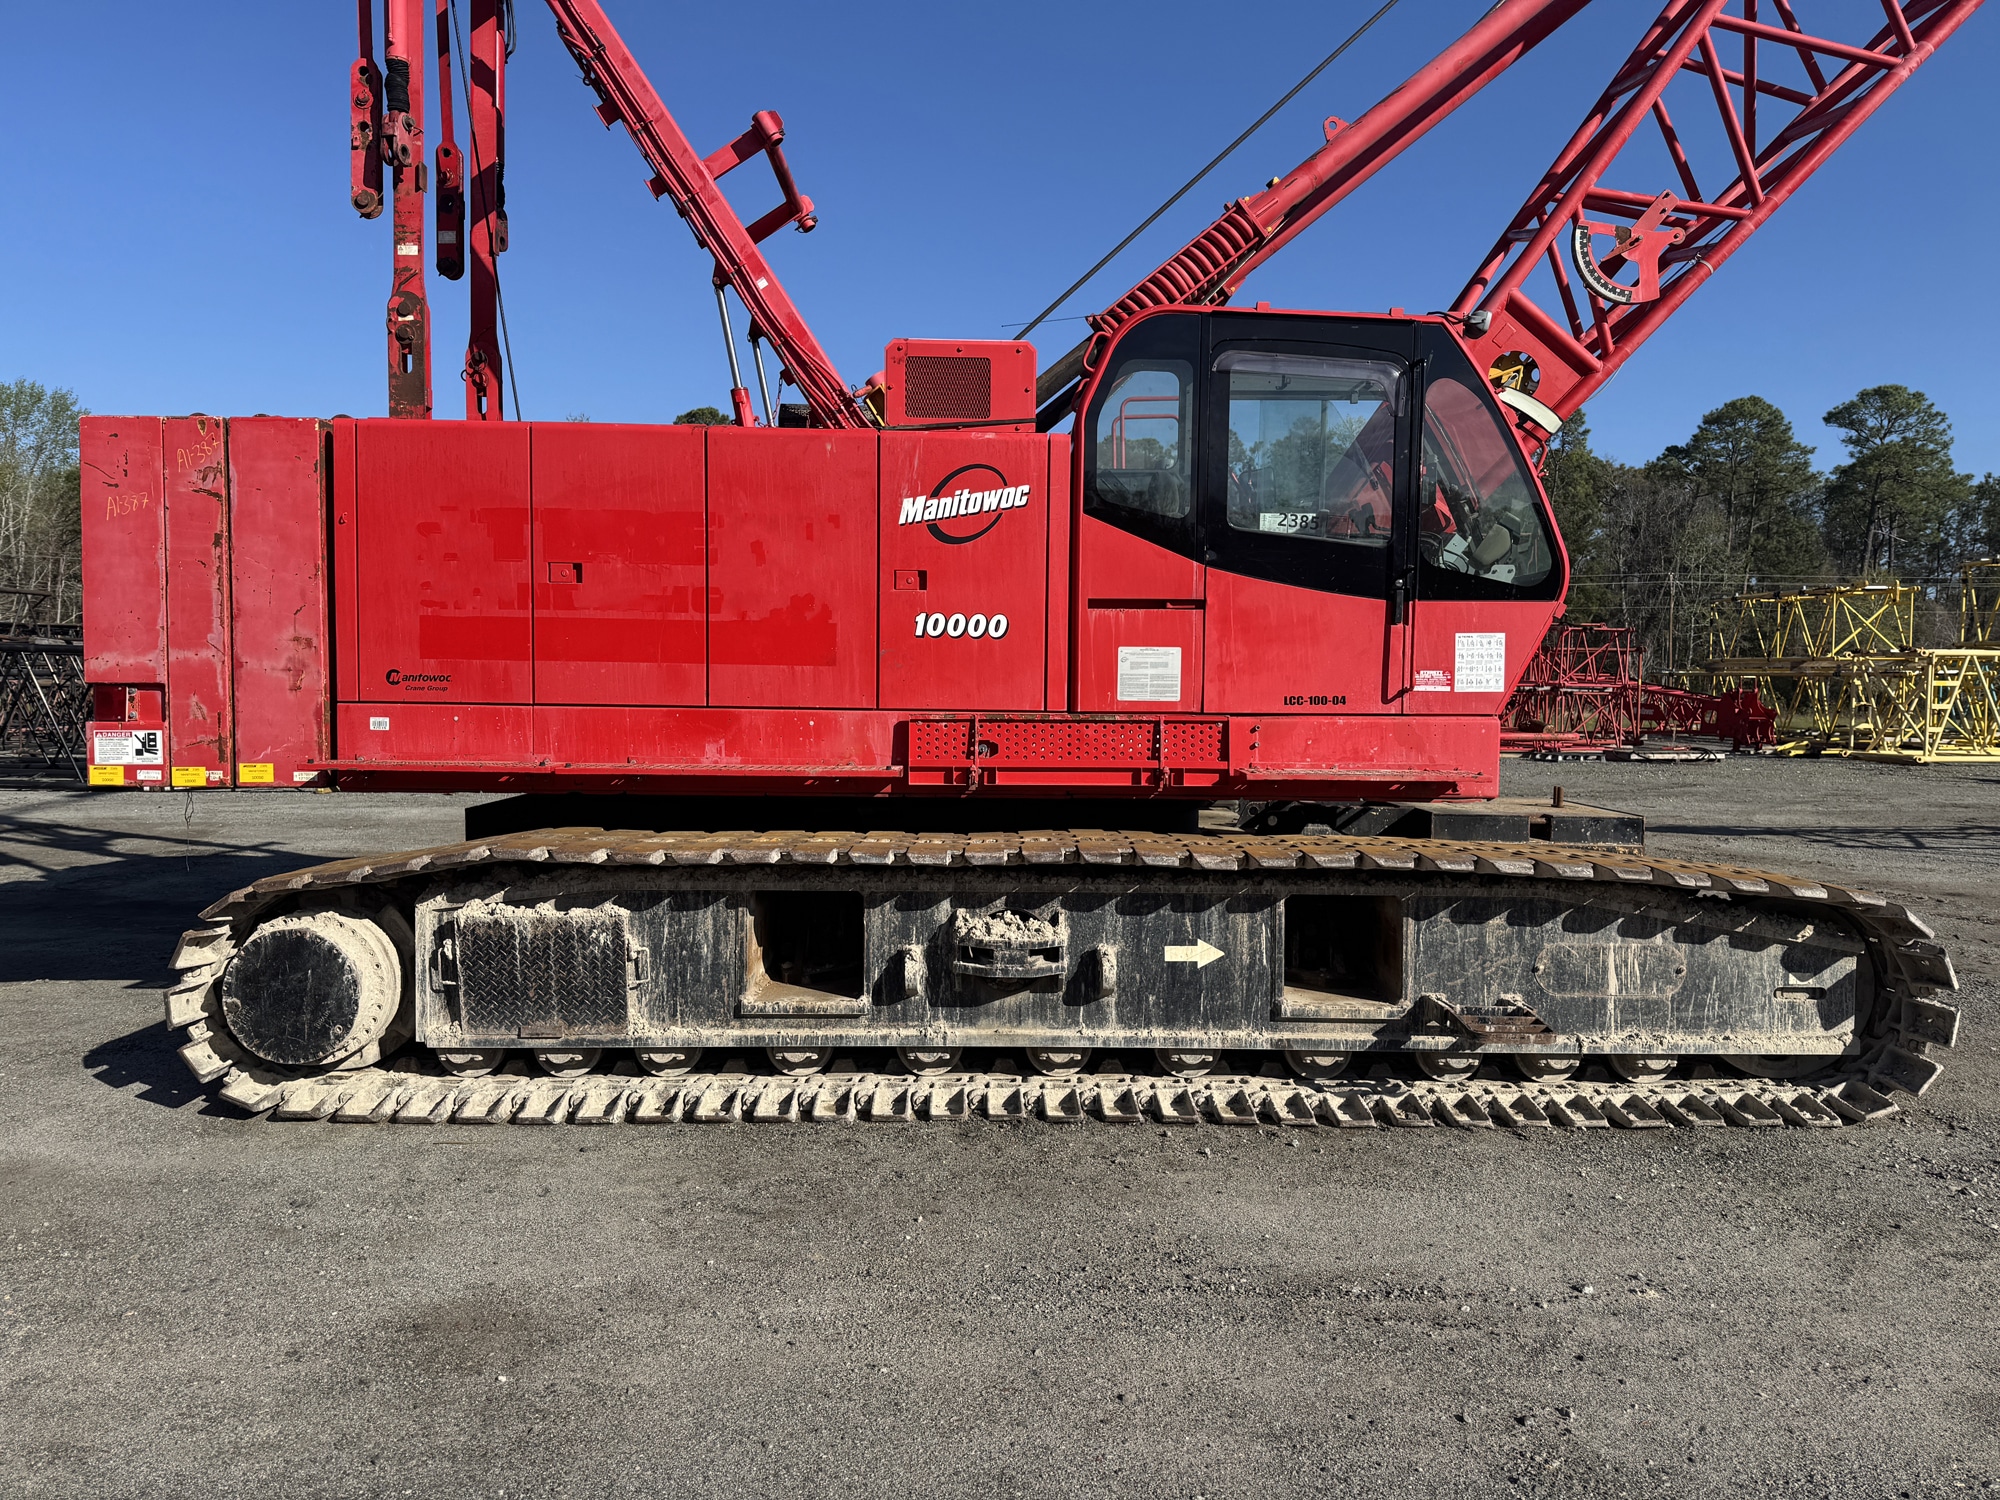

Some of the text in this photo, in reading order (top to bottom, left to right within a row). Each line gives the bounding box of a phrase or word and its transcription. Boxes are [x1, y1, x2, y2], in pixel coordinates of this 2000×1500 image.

[898, 485, 1030, 525] Manitowoc
[1278, 513, 1319, 530] 2385
[915, 612, 1009, 640] 10000
[386, 669, 451, 685] Manitowoc
[1283, 695, 1347, 706] LCC-100-04
